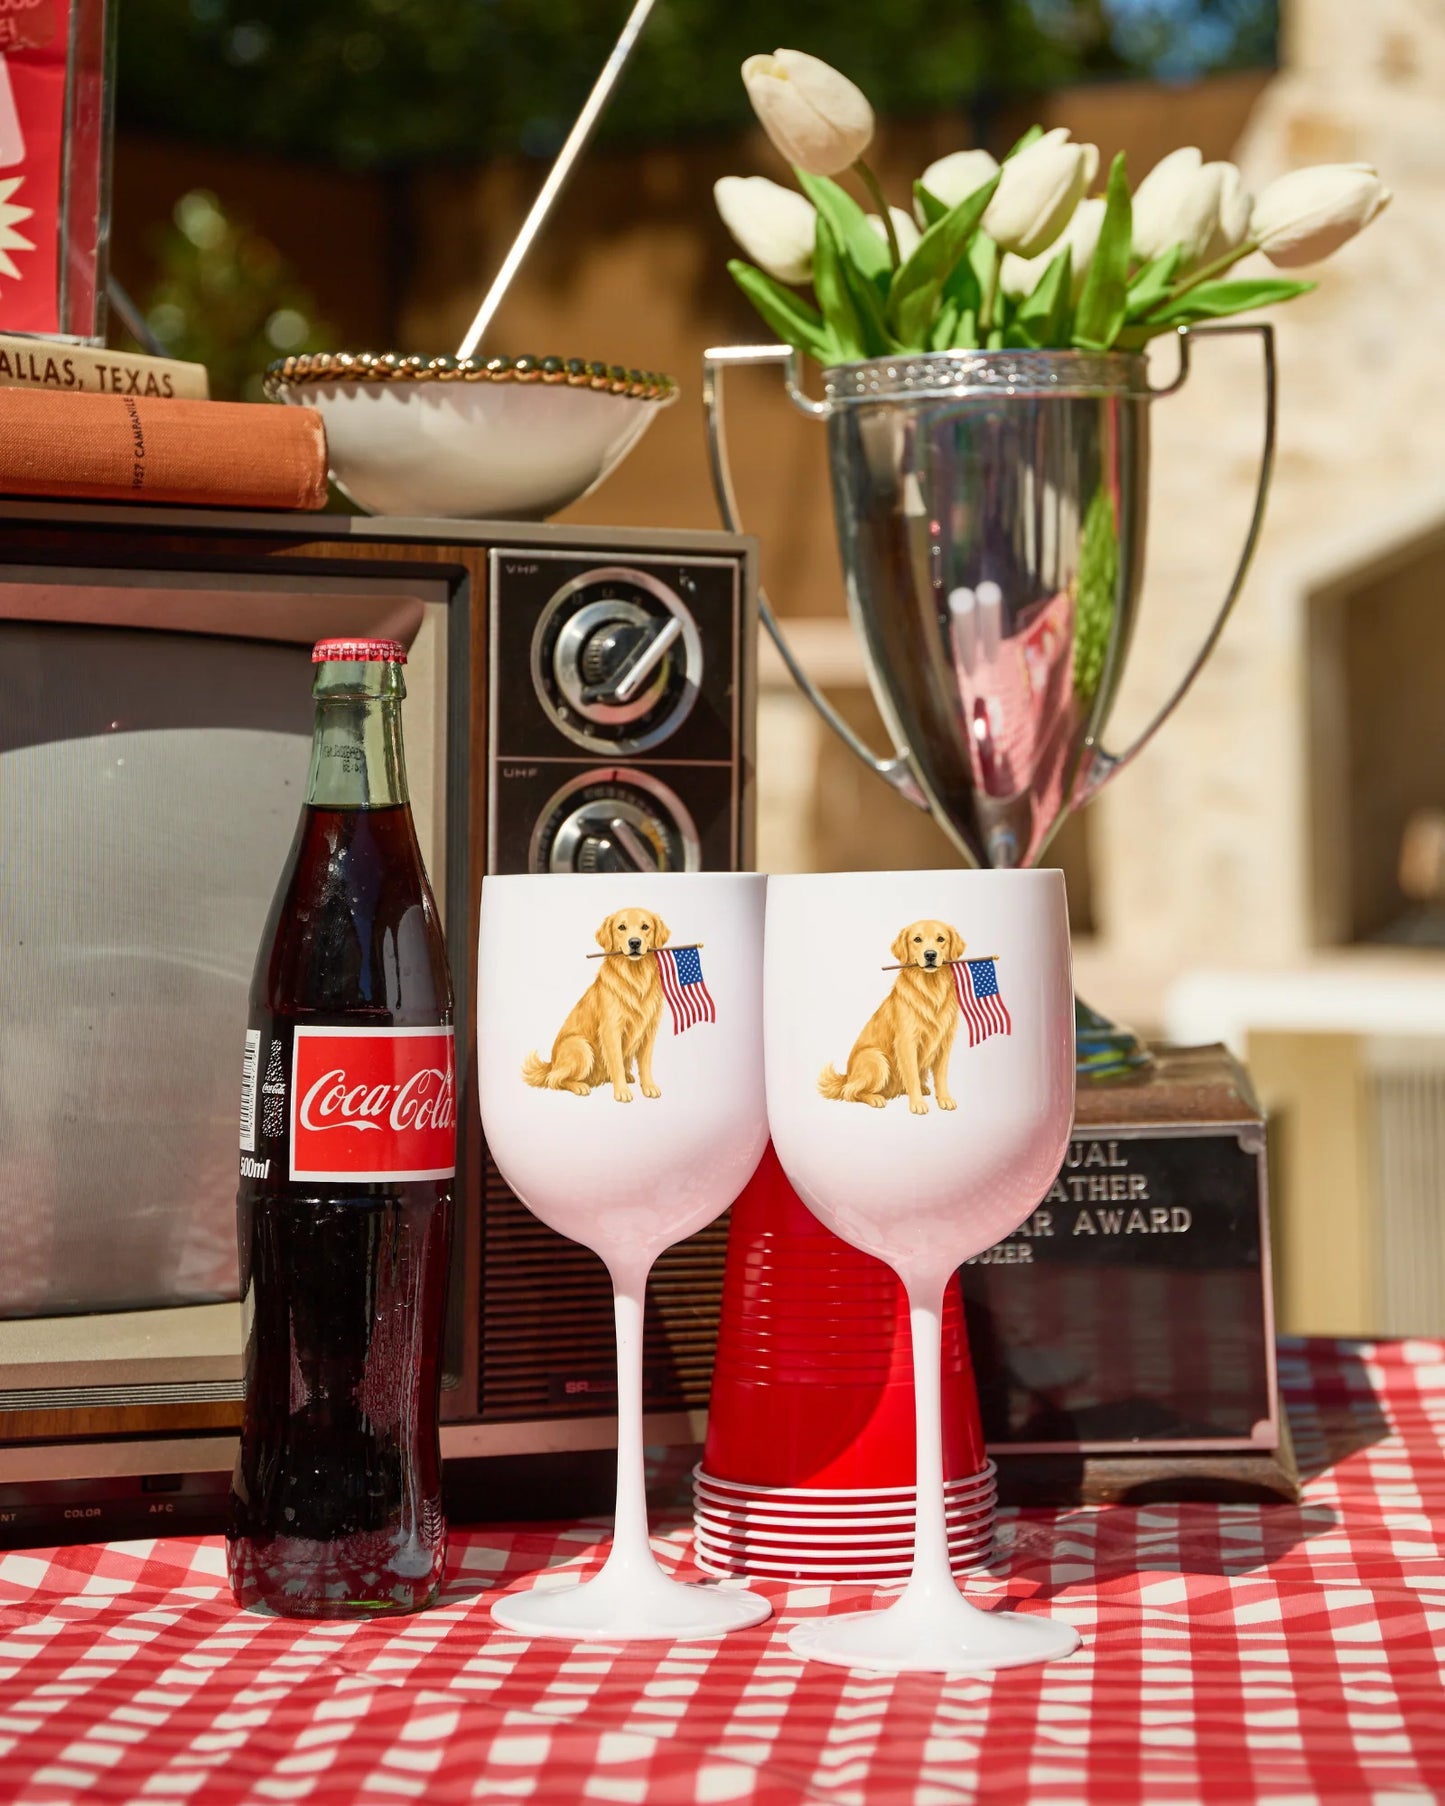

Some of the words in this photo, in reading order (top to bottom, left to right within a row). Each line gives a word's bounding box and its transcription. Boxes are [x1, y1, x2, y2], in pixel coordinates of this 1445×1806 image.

[0, 351, 83, 390] ALLAS,
[95, 364, 175, 398] TEXAS
[123, 397, 145, 458] CAMPANILE
[131, 463, 145, 490] 1957
[505, 563, 539, 575] VHF
[503, 767, 538, 779] UHF
[299, 1068, 453, 1132] Coca-Cola
[1065, 1141, 1128, 1168] UAL
[239, 1157, 271, 1180] 500ml
[1072, 1206, 1192, 1236] AWARD
[64, 1508, 101, 1519] COLOR
[149, 1504, 174, 1513] AFC
